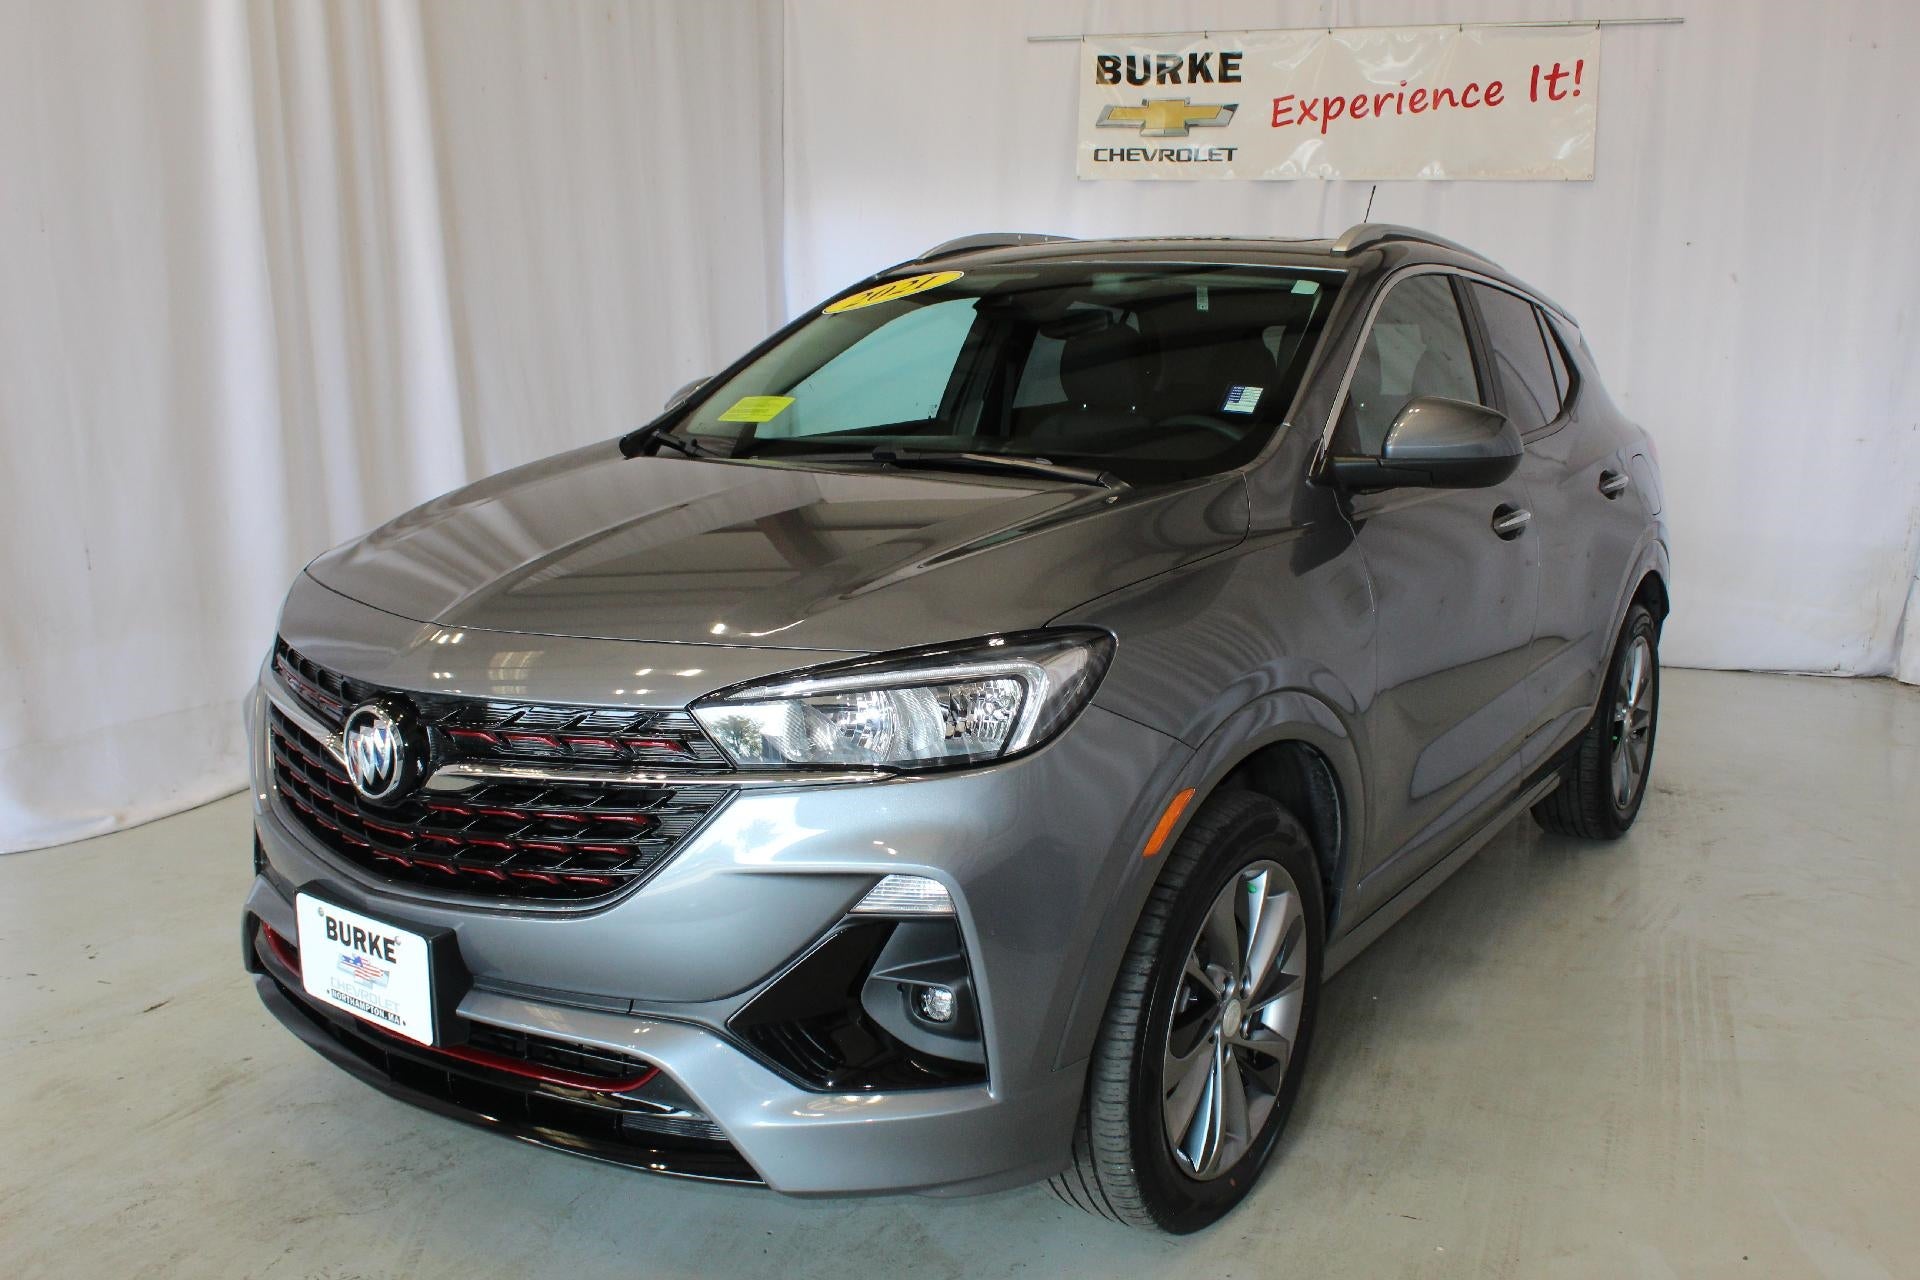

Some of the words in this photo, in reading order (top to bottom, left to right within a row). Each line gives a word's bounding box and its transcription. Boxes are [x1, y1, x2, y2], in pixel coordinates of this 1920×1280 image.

[1096, 51, 1243, 86] BURKE
[1270, 79, 1505, 134] Experience
[1530, 60, 1584, 103] It!
[1093, 146, 1238, 163] CHEVROLET
[326, 916, 397, 963] BURKE
[330, 976, 399, 1012] CHEVROLET
[388, 1012, 400, 1025] MA
